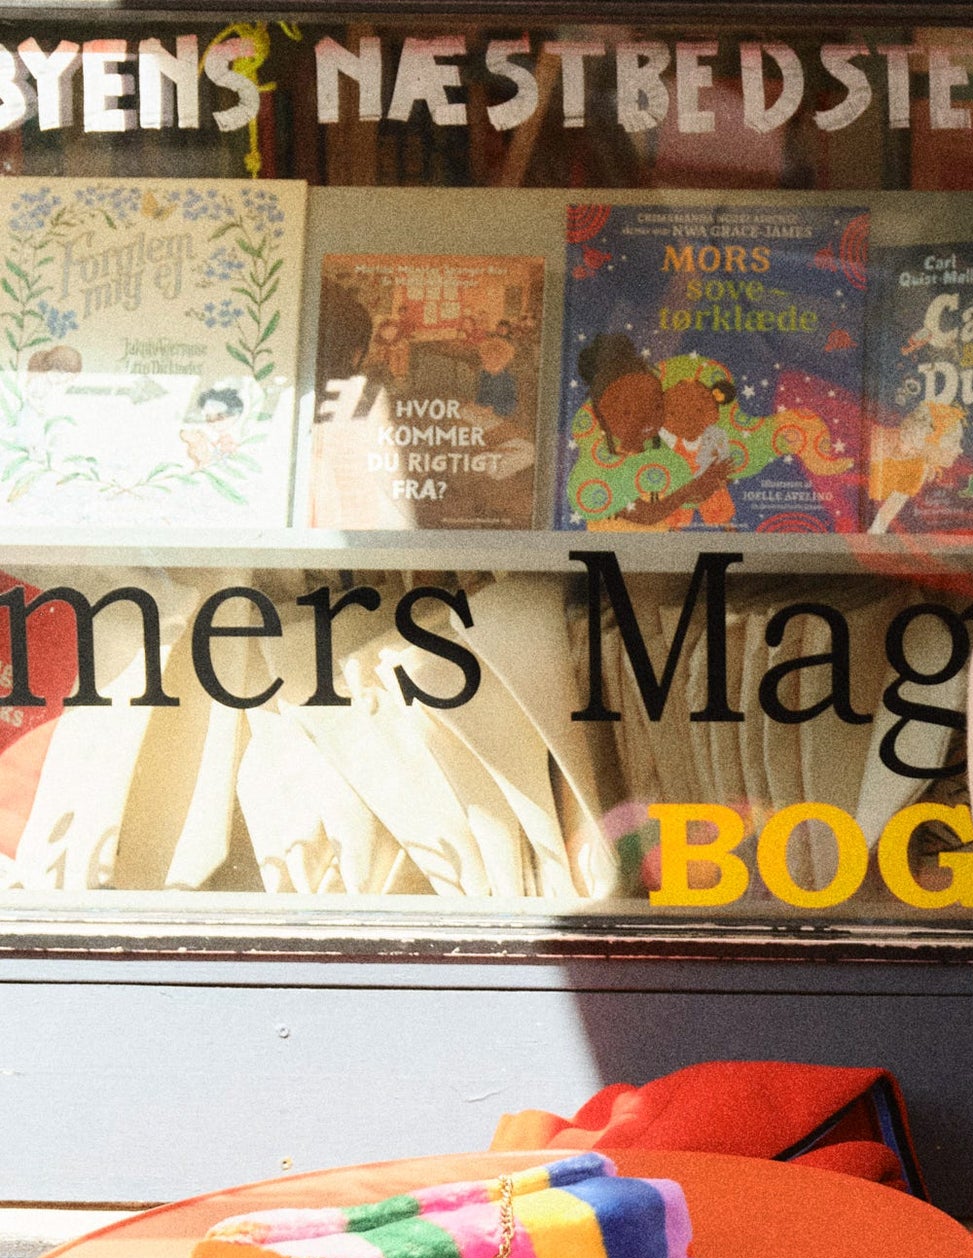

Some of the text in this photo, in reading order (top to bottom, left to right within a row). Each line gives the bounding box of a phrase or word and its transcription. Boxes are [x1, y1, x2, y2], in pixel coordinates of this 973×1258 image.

[660, 244, 771, 273] MORS
[924, 252, 957, 271] Carl
[659, 304, 819, 332] tørklæde
[395, 399, 462, 420] HVOR
[377, 425, 487, 447] KOMMER
[367, 452, 503, 474] DU RIGTIGT
[392, 479, 448, 501] FRA?
